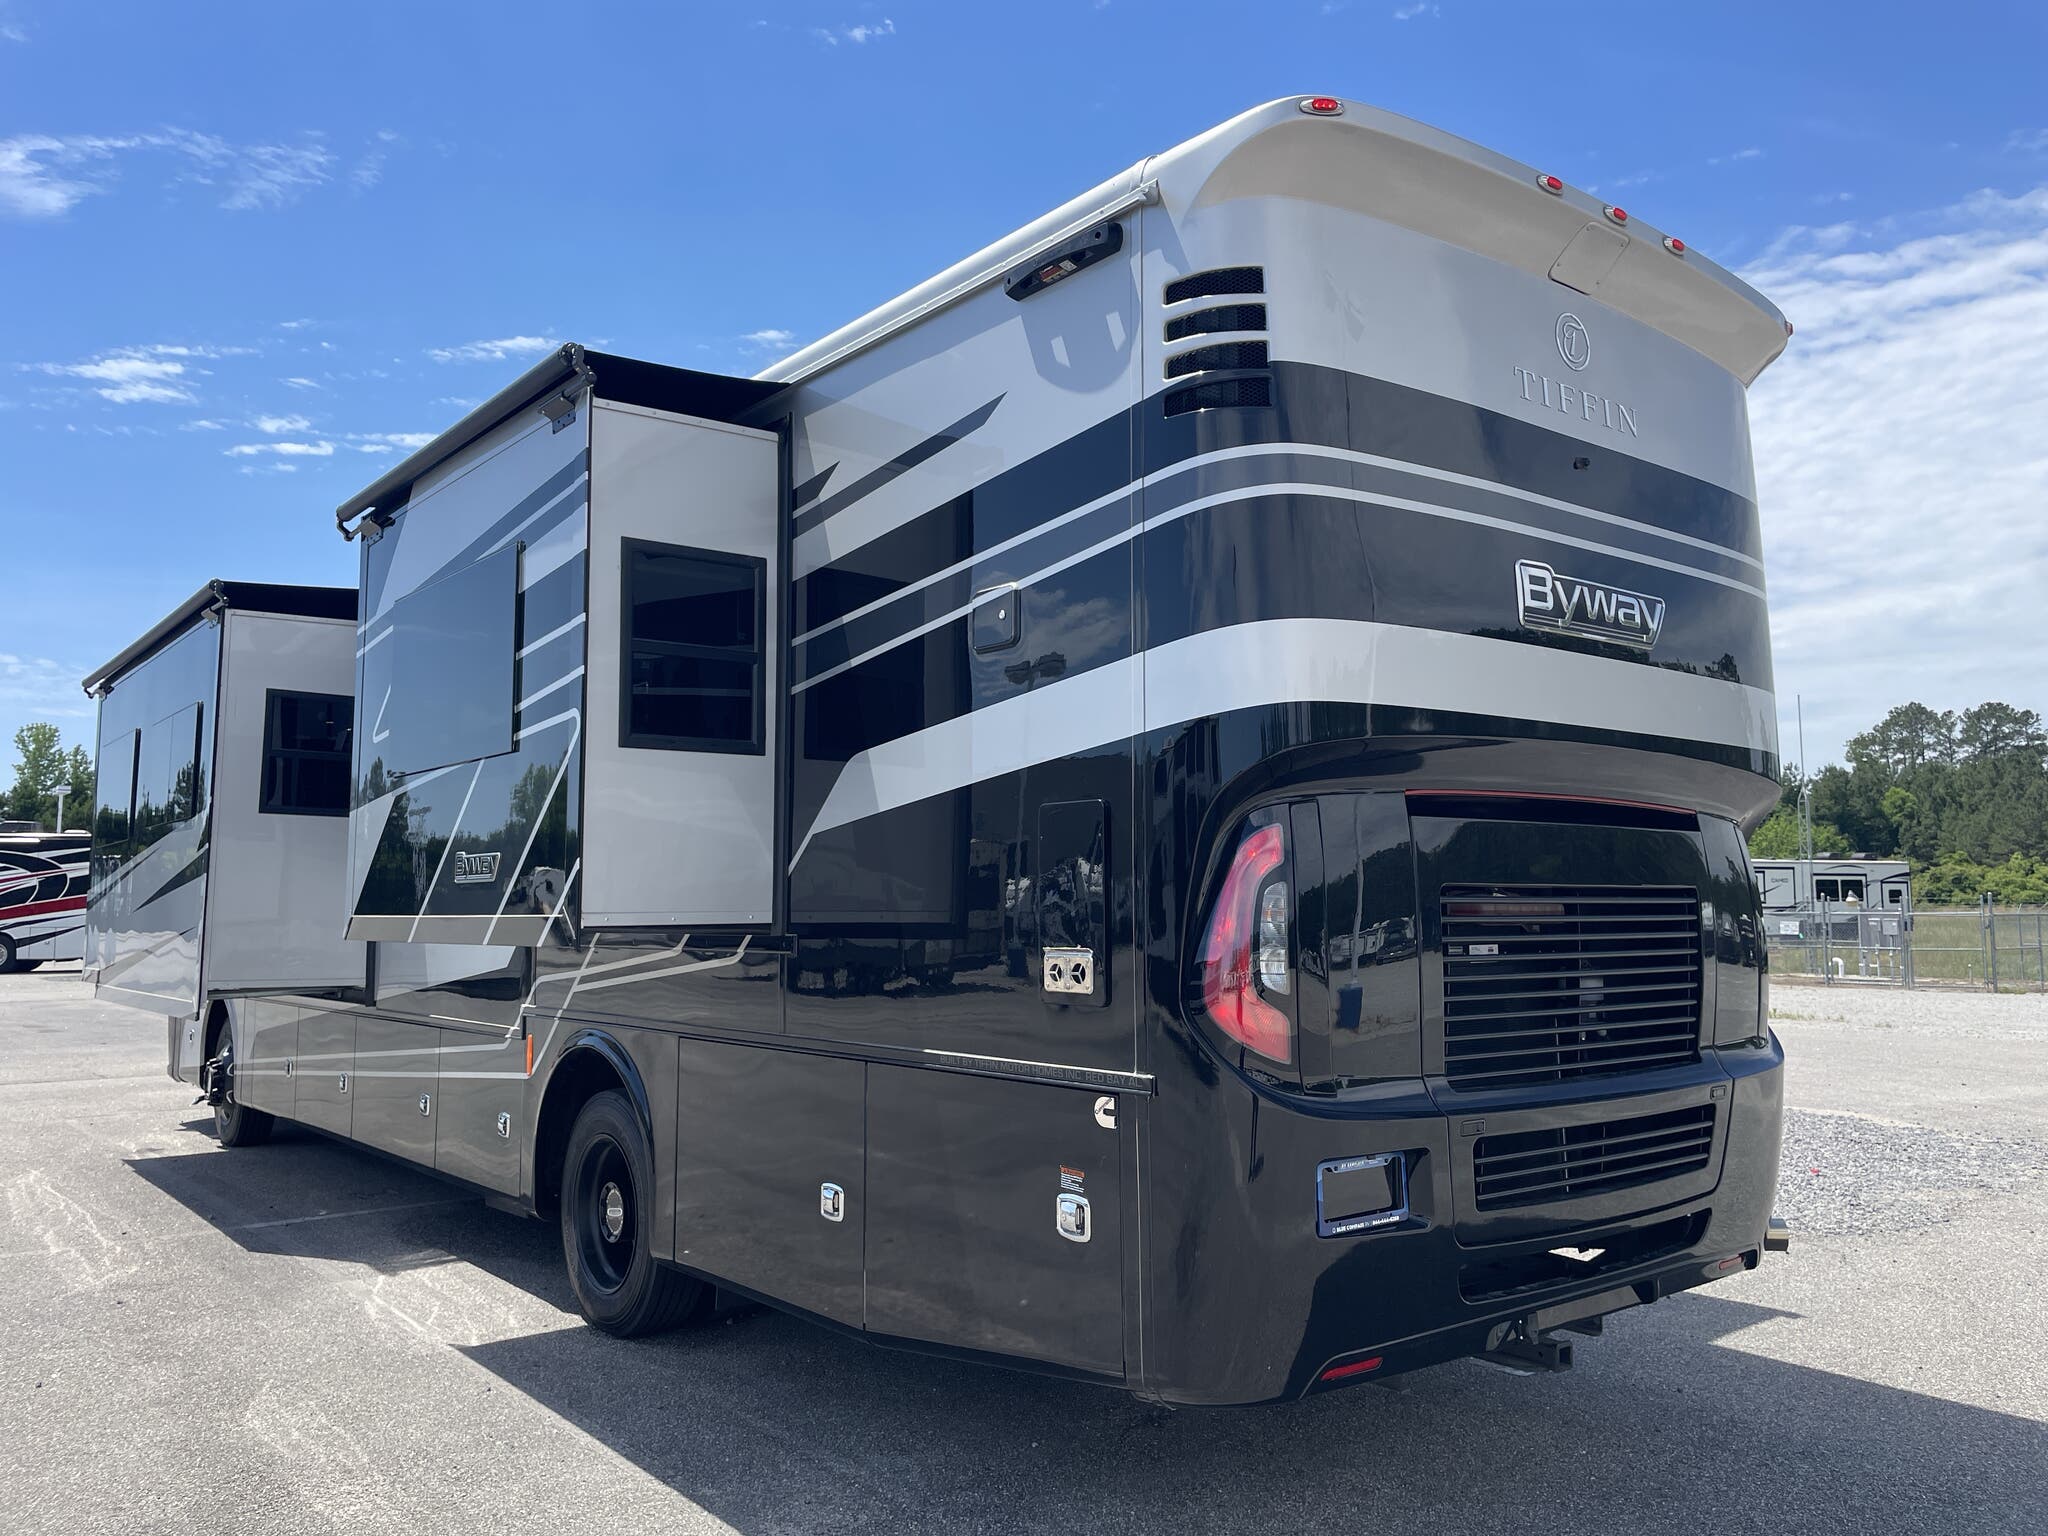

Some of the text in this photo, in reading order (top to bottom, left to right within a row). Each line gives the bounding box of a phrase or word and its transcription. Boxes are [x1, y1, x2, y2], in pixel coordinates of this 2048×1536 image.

[1513, 365, 1638, 438] TIFFIN
[1520, 565, 1663, 643] Byway
[940, 1055, 960, 1065] BUILT
[962, 1057, 972, 1066] BY
[974, 1058, 998, 1071] TIFFIN
[1000, 1062, 1030, 1073] MOTOR
[1031, 1065, 1064, 1078] HOMES
[1085, 1071, 1104, 1082] RED
